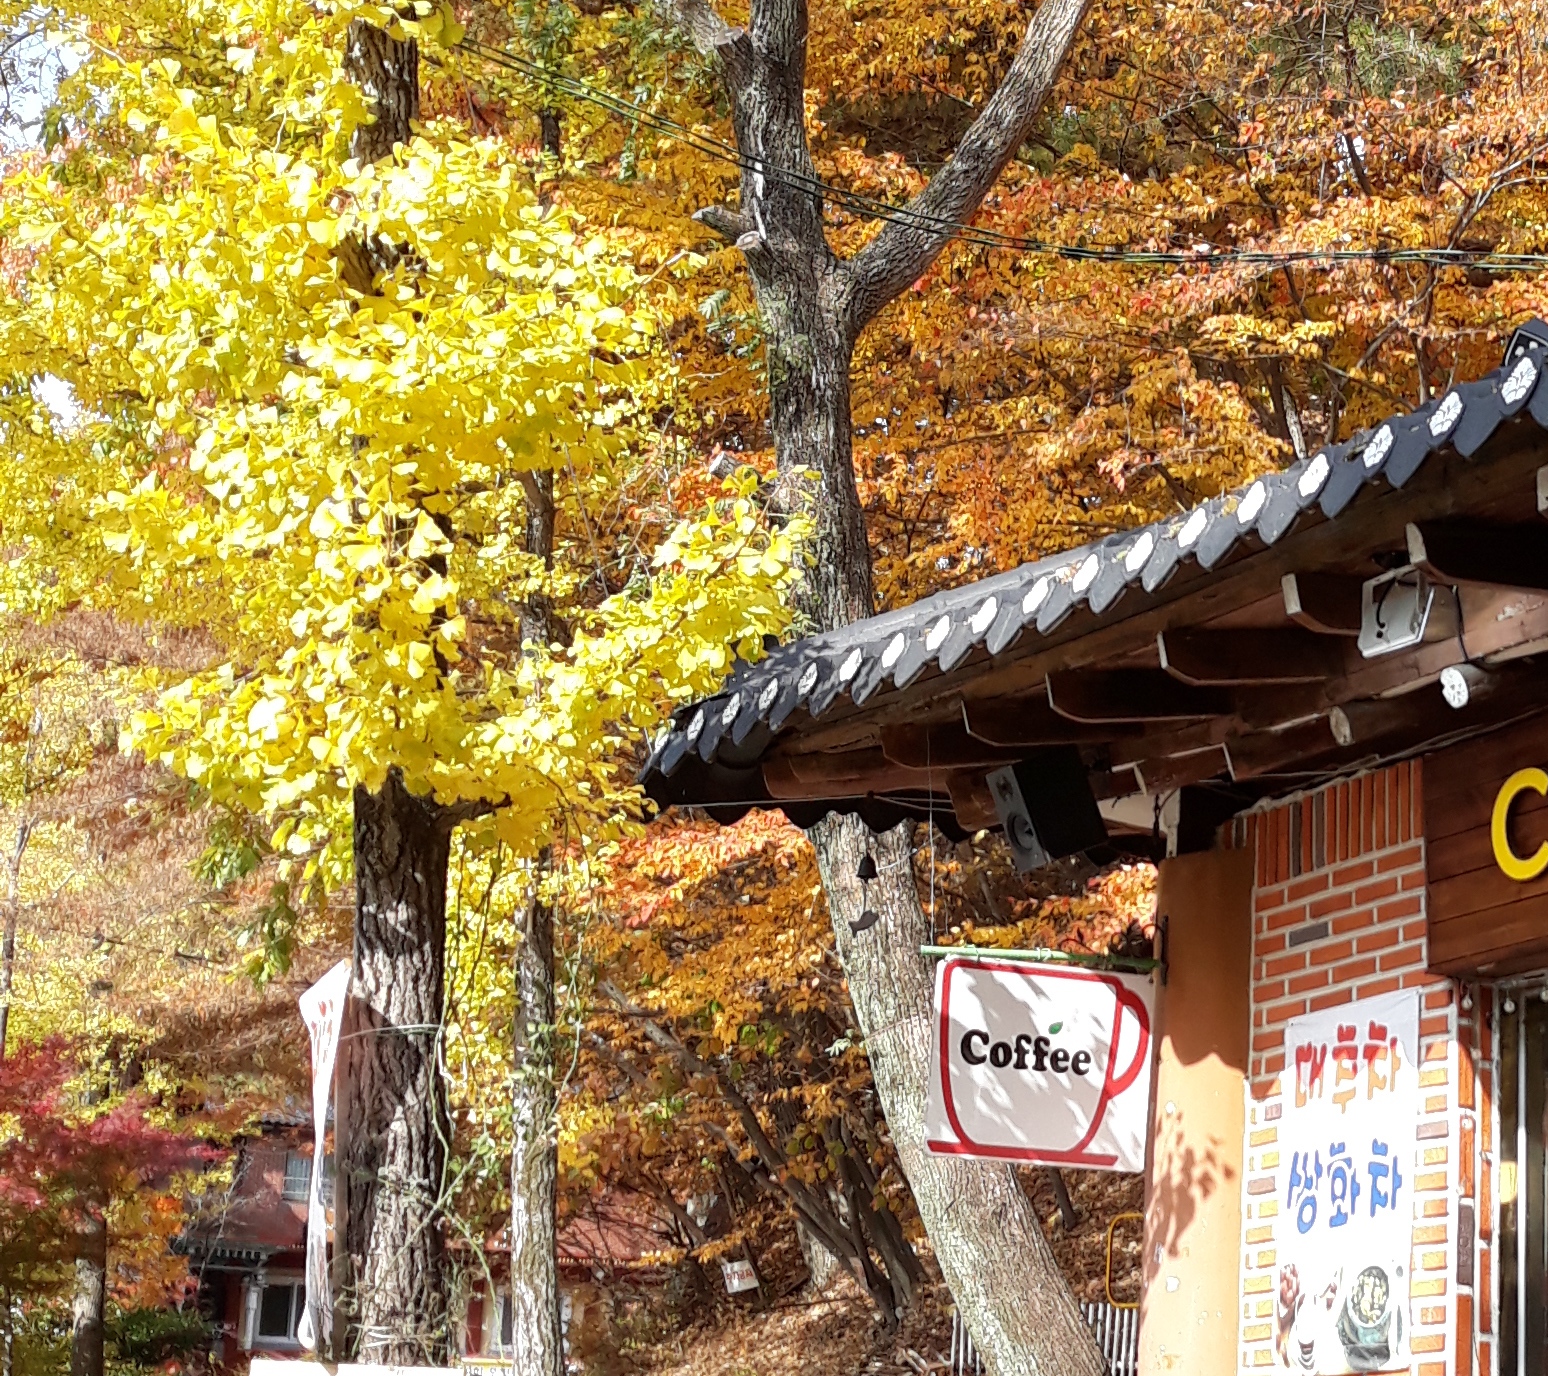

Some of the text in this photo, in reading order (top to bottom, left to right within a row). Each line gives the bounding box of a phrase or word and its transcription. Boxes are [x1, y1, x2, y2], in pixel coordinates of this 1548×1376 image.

[960, 1028, 1092, 1076] Coffee
[1294, 1020, 1402, 1114] 대추차
[1286, 1137, 1402, 1234] 쌍화차
